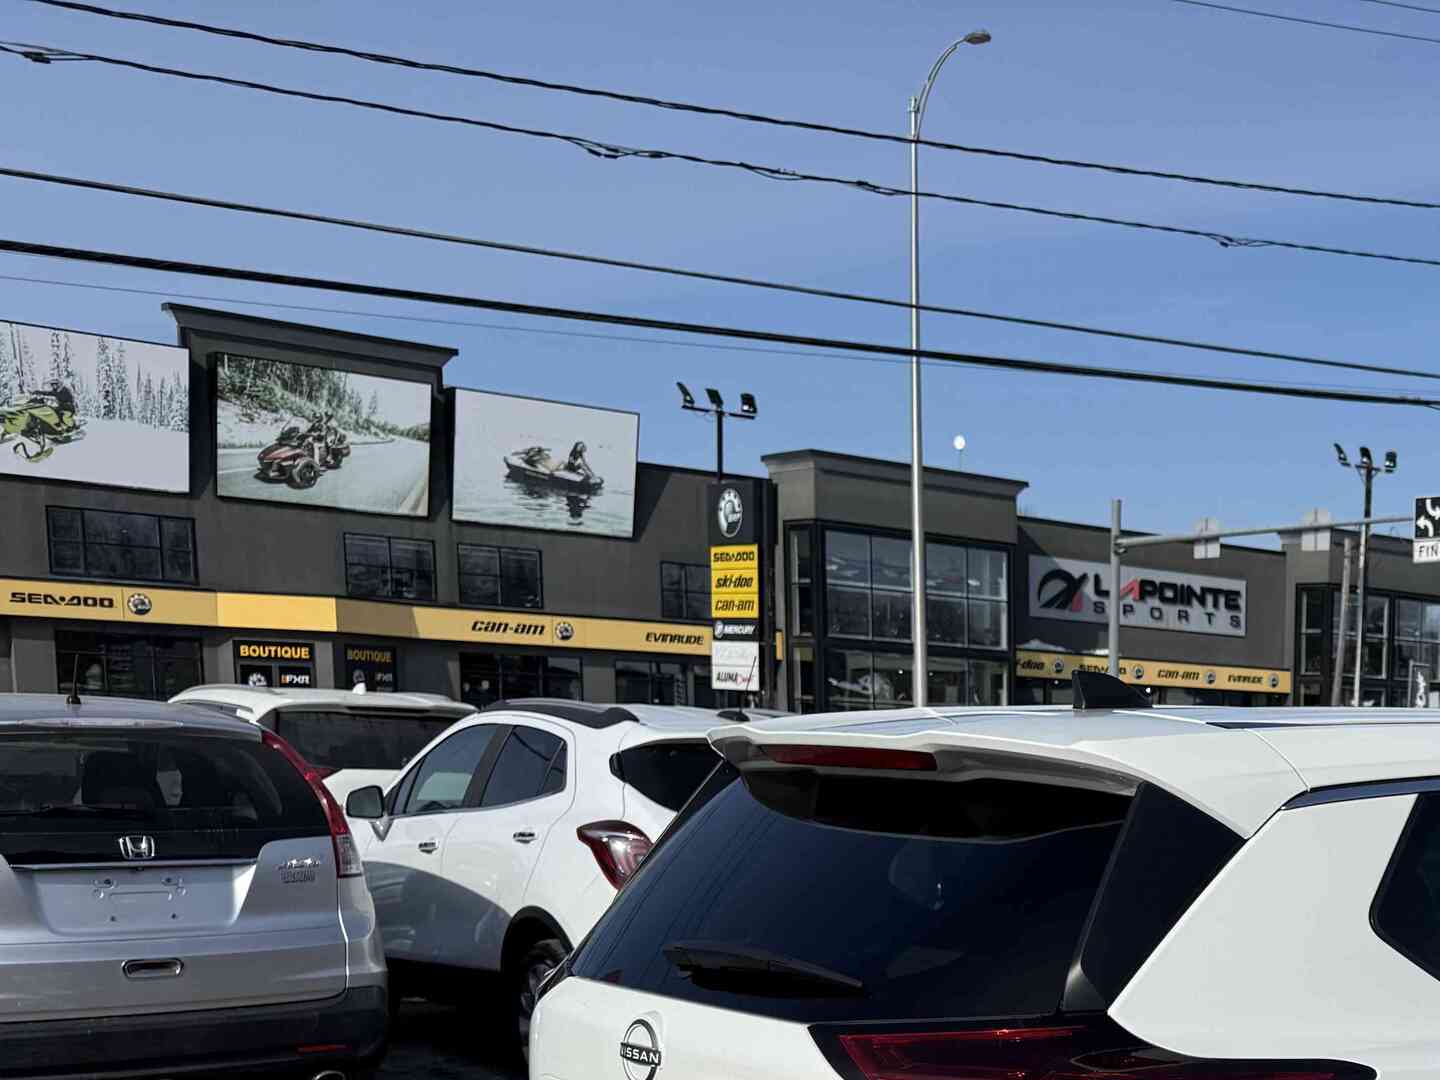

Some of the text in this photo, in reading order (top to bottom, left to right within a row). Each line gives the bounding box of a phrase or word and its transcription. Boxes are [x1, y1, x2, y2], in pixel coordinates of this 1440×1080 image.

[1418, 545, 1439, 558] FIN
[715, 574, 754, 589] ski-doo
[1093, 573, 1242, 611] LAPOINTE
[1093, 601, 1242, 629] SPORTS
[471, 620, 545, 636] can-am
[645, 632, 704, 645] EVINRUDE
[239, 645, 310, 659] BOUTIQUE
